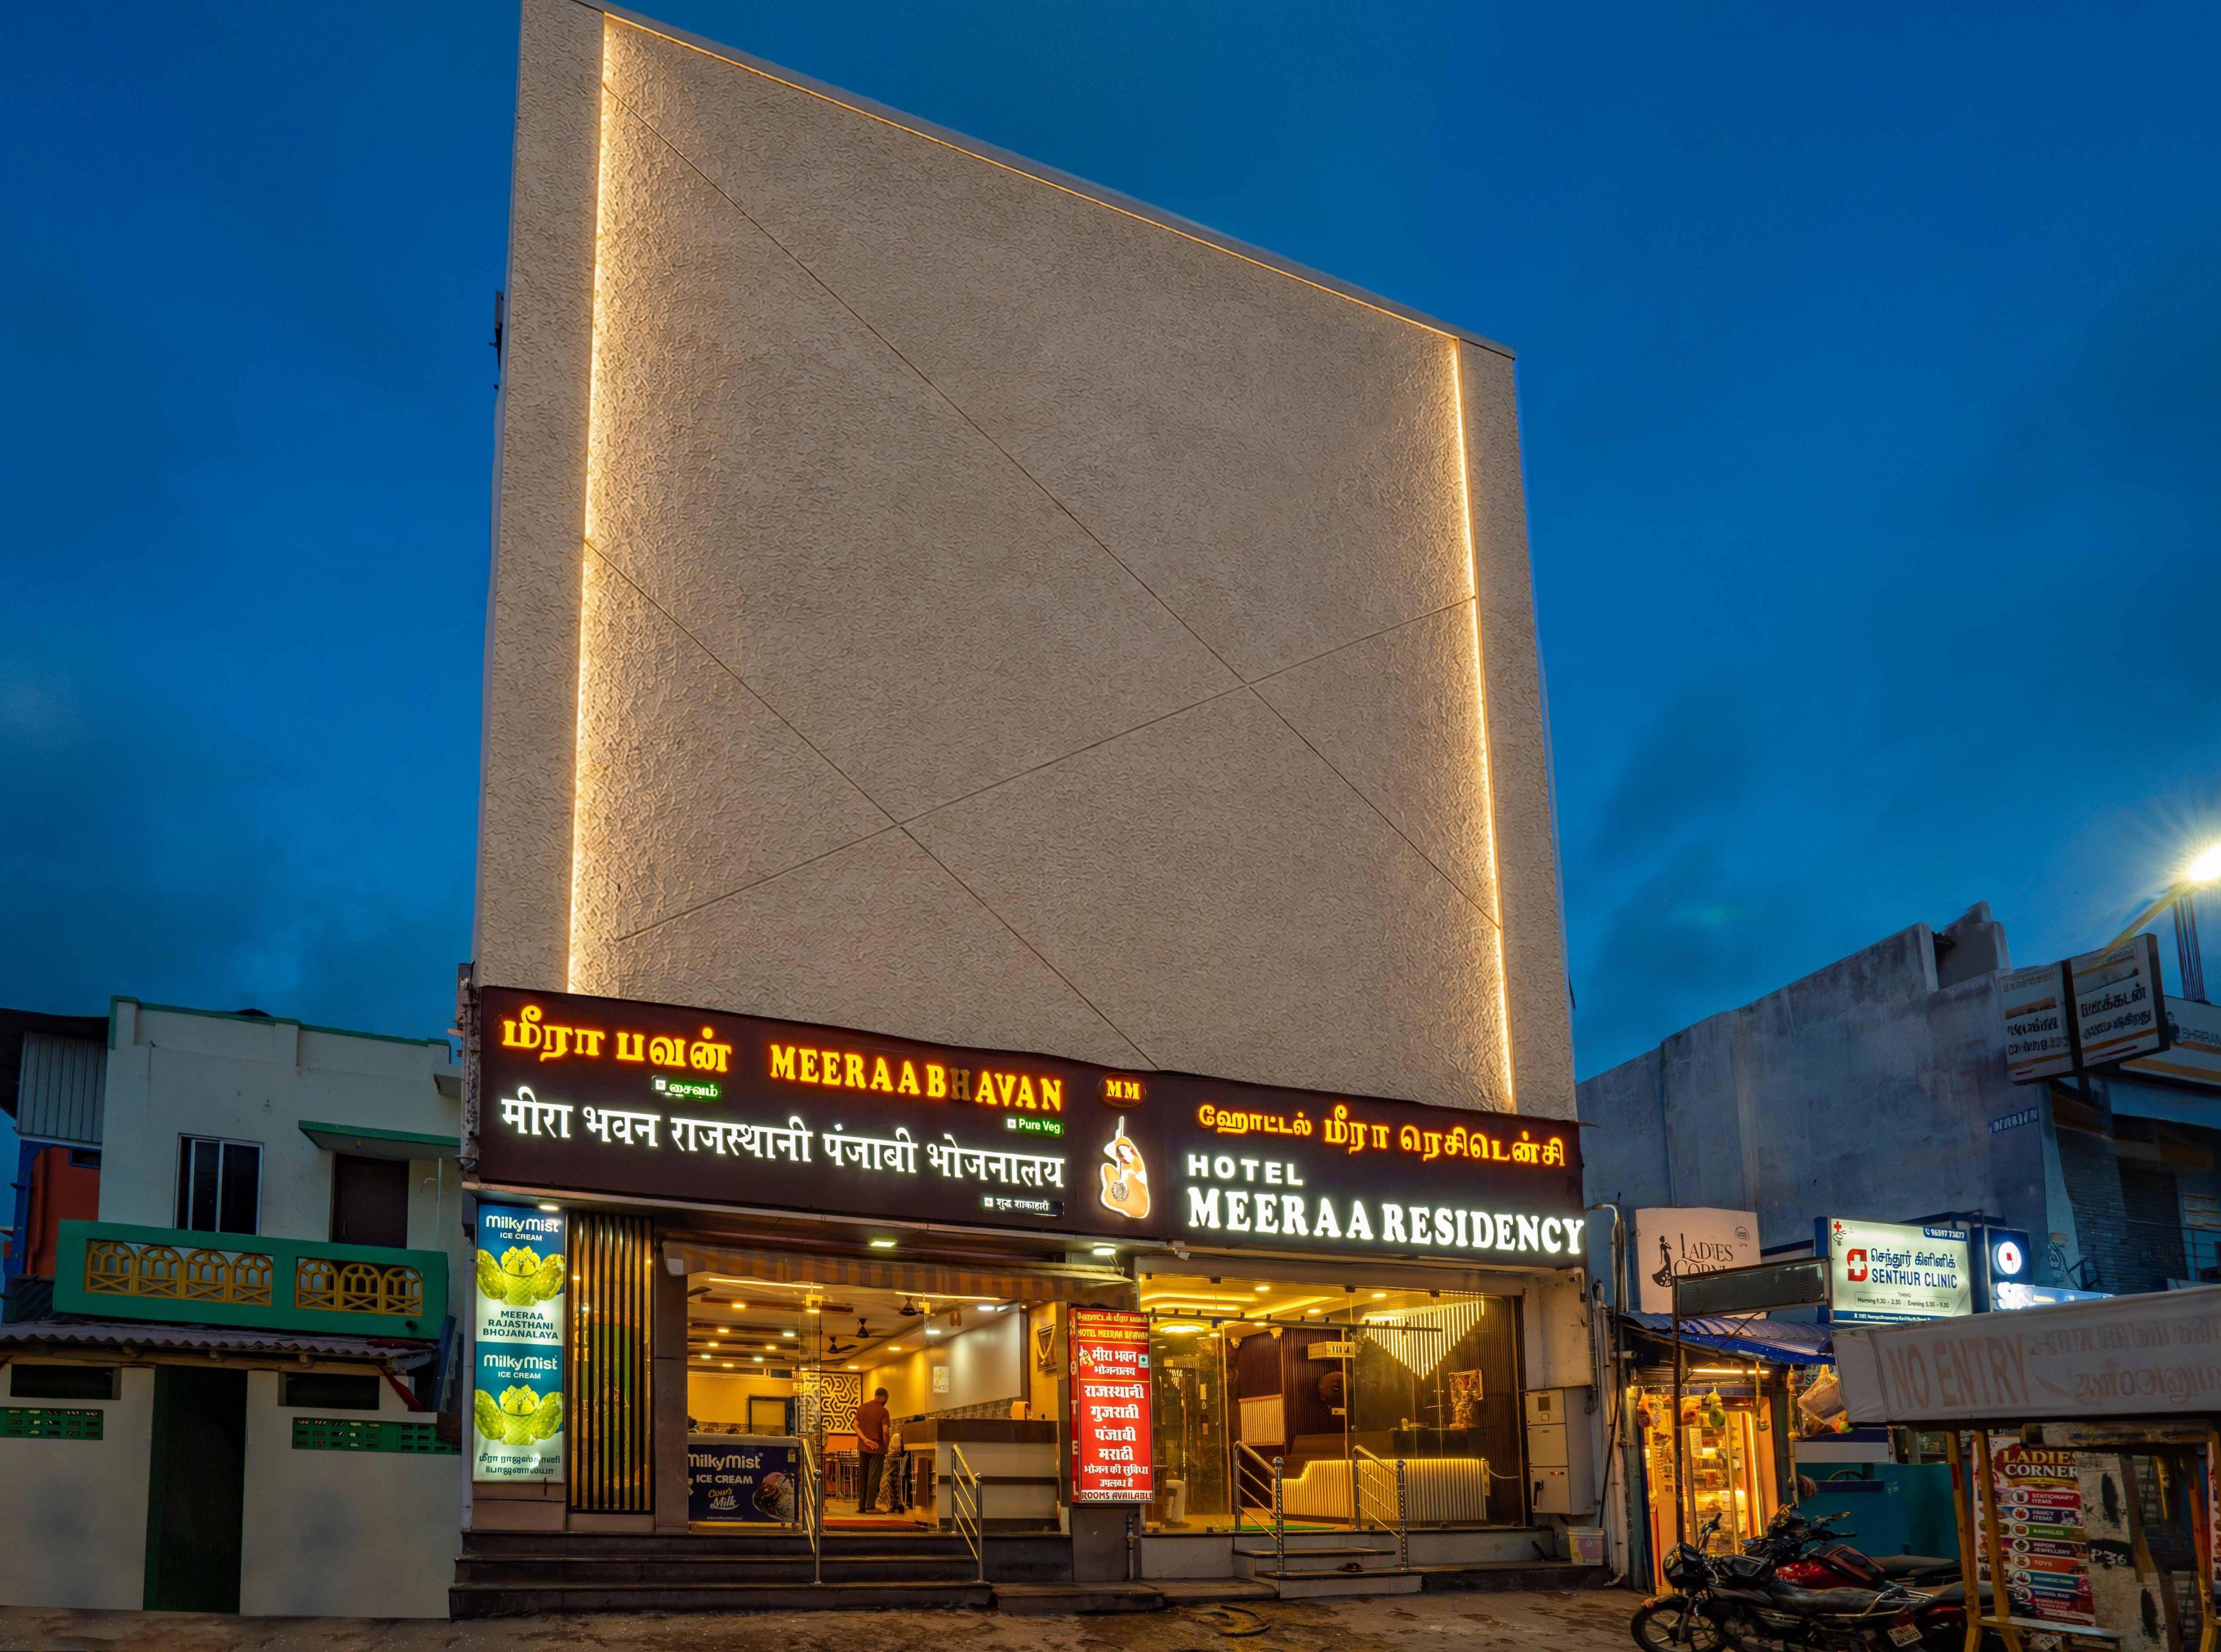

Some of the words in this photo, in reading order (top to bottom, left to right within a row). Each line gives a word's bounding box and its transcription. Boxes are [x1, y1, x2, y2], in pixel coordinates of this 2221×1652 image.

[502, 1005, 605, 1062] மீரா
[616, 1027, 731, 1073] பவன்
[669, 1083, 718, 1098] சைவம்
[1019, 1118, 1040, 1130] Pure
[1042, 1120, 1060, 1134] Veg
[501, 1086, 573, 1138] मीरा
[582, 1107, 660, 1148] भवन
[670, 1116, 813, 1162] राजस्थानी
[823, 1123, 918, 1174] पंजाबी
[927, 1133, 1065, 1188] भोजनालय
[1198, 1105, 1312, 1135] ஹோட்டல்
[1324, 1105, 1390, 1155] மீரா
[1400, 1125, 1566, 1167] ரெசிடென்சி
[1187, 1154, 1303, 1186] HOTEL
[996, 1198, 1012, 1210] शुद्ध
[1014, 1200, 1049, 1211] शाकाहारी
[1187, 1187, 1374, 1240] MEERAA
[1382, 1203, 1585, 1255] RESIDENCY
[515, 1233, 542, 1241] CREAM
[1931, 1229, 1948, 1237] 96597
[1680, 1233, 1733, 1263] LADIES
[1871, 1248, 1912, 1268] செந்தூர்
[1915, 1252, 1956, 1268] கிளினிக்
[1871, 1268, 1921, 1286] SENTHUR
[1924, 1272, 1957, 1289] CLINIC
[500, 1310, 544, 1320] MEERAA
[1113, 1313, 1129, 1323] மீரா
[488, 1319, 554, 1330] RAJASTHANI
[483, 1328, 559, 1340] BHOJANALAYA
[1077, 1328, 1096, 1338] HOTEL
[1098, 1329, 1123, 1339] MEERAA
[1091, 1346, 1113, 1362] मीरा
[1114, 1350, 1137, 1363] भवन
[1094, 1364, 1136, 1376] भोजनालय
[1888, 1344, 1929, 1410] NO
[1932, 1333, 2032, 1408] ENTRY
[1083, 1383, 1145, 1399] राजस्थानी
[1090, 1403, 1140, 1422] गुजराती
[1094, 1425, 1137, 1441] पंजाबी
[479, 1452, 498, 1463] மீரா
[1098, 1445, 1134, 1460] मराठी
[485, 1465, 554, 1476] போஜனாலயா
[1084, 1463, 1109, 1474] भोजन
[1110, 1463, 1121, 1474] की
[1122, 1464, 1149, 1476] सुविधा
[2004, 1464, 2078, 1478] CORNER
[696, 1474, 713, 1483] ICE
[715, 1474, 753, 1485] CREAM
[1099, 1479, 1127, 1488] उपलब्ध
[1127, 1477, 1134, 1487] है
[708, 1487, 733, 1498] Cow's
[1081, 1492, 1110, 1500] ROOMS
[710, 1495, 740, 1510] Milk
